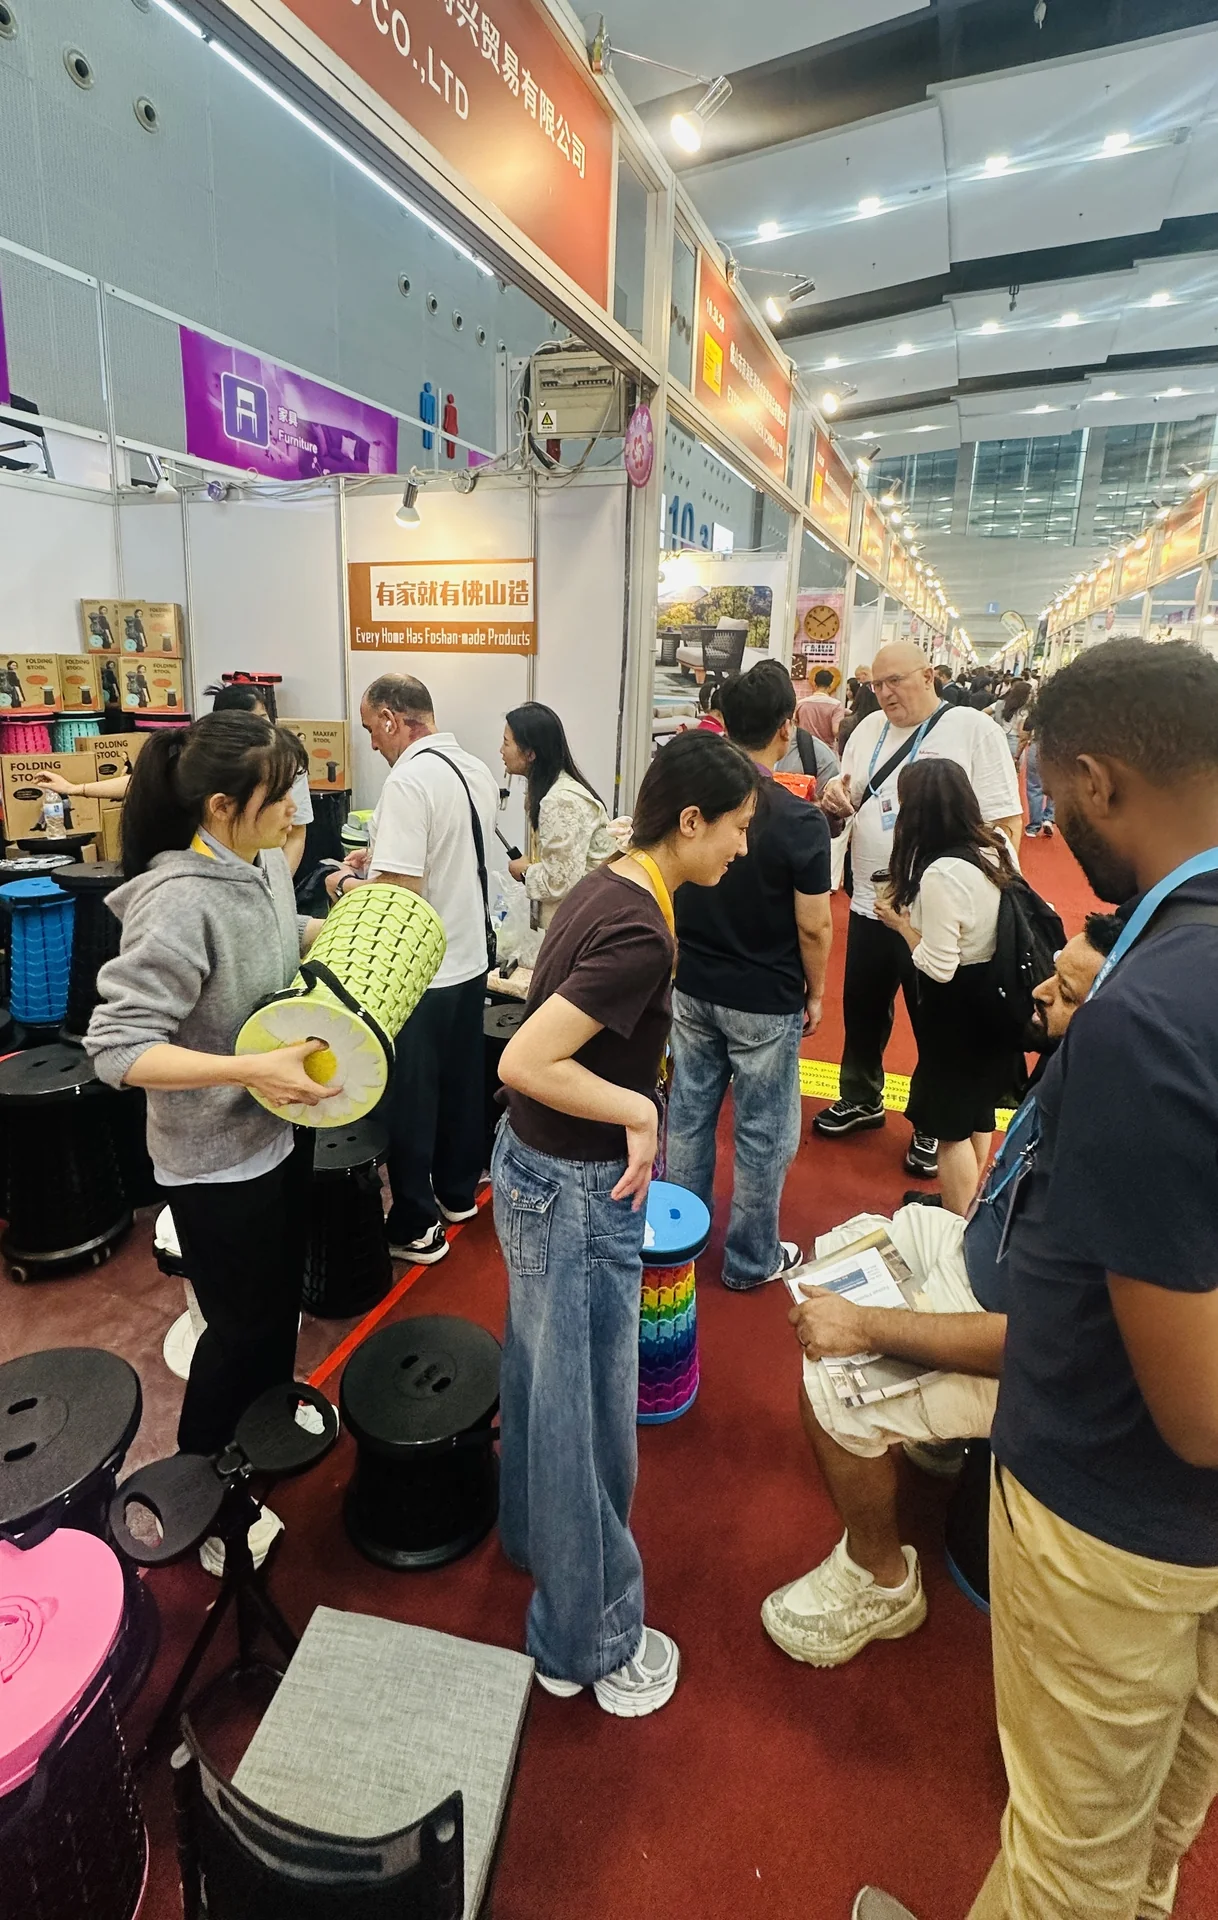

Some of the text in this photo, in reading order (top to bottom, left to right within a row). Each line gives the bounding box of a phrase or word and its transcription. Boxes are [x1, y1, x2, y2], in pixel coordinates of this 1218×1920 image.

[371, 0, 469, 120] CO.,LTD
[442, 0, 586, 179] 兴贸易有限公司
[278, 406, 299, 428] 家具
[278, 429, 318, 454] Furniture
[375, 579, 529, 607] 有家就有佛山造
[356, 626, 531, 648] Every Home Has Foshan-made Products
[94, 740, 129, 750] FOLDING
[97, 750, 121, 760] STOOL
[10, 760, 62, 771] FOLDING
[11, 773, 34, 783] STO
